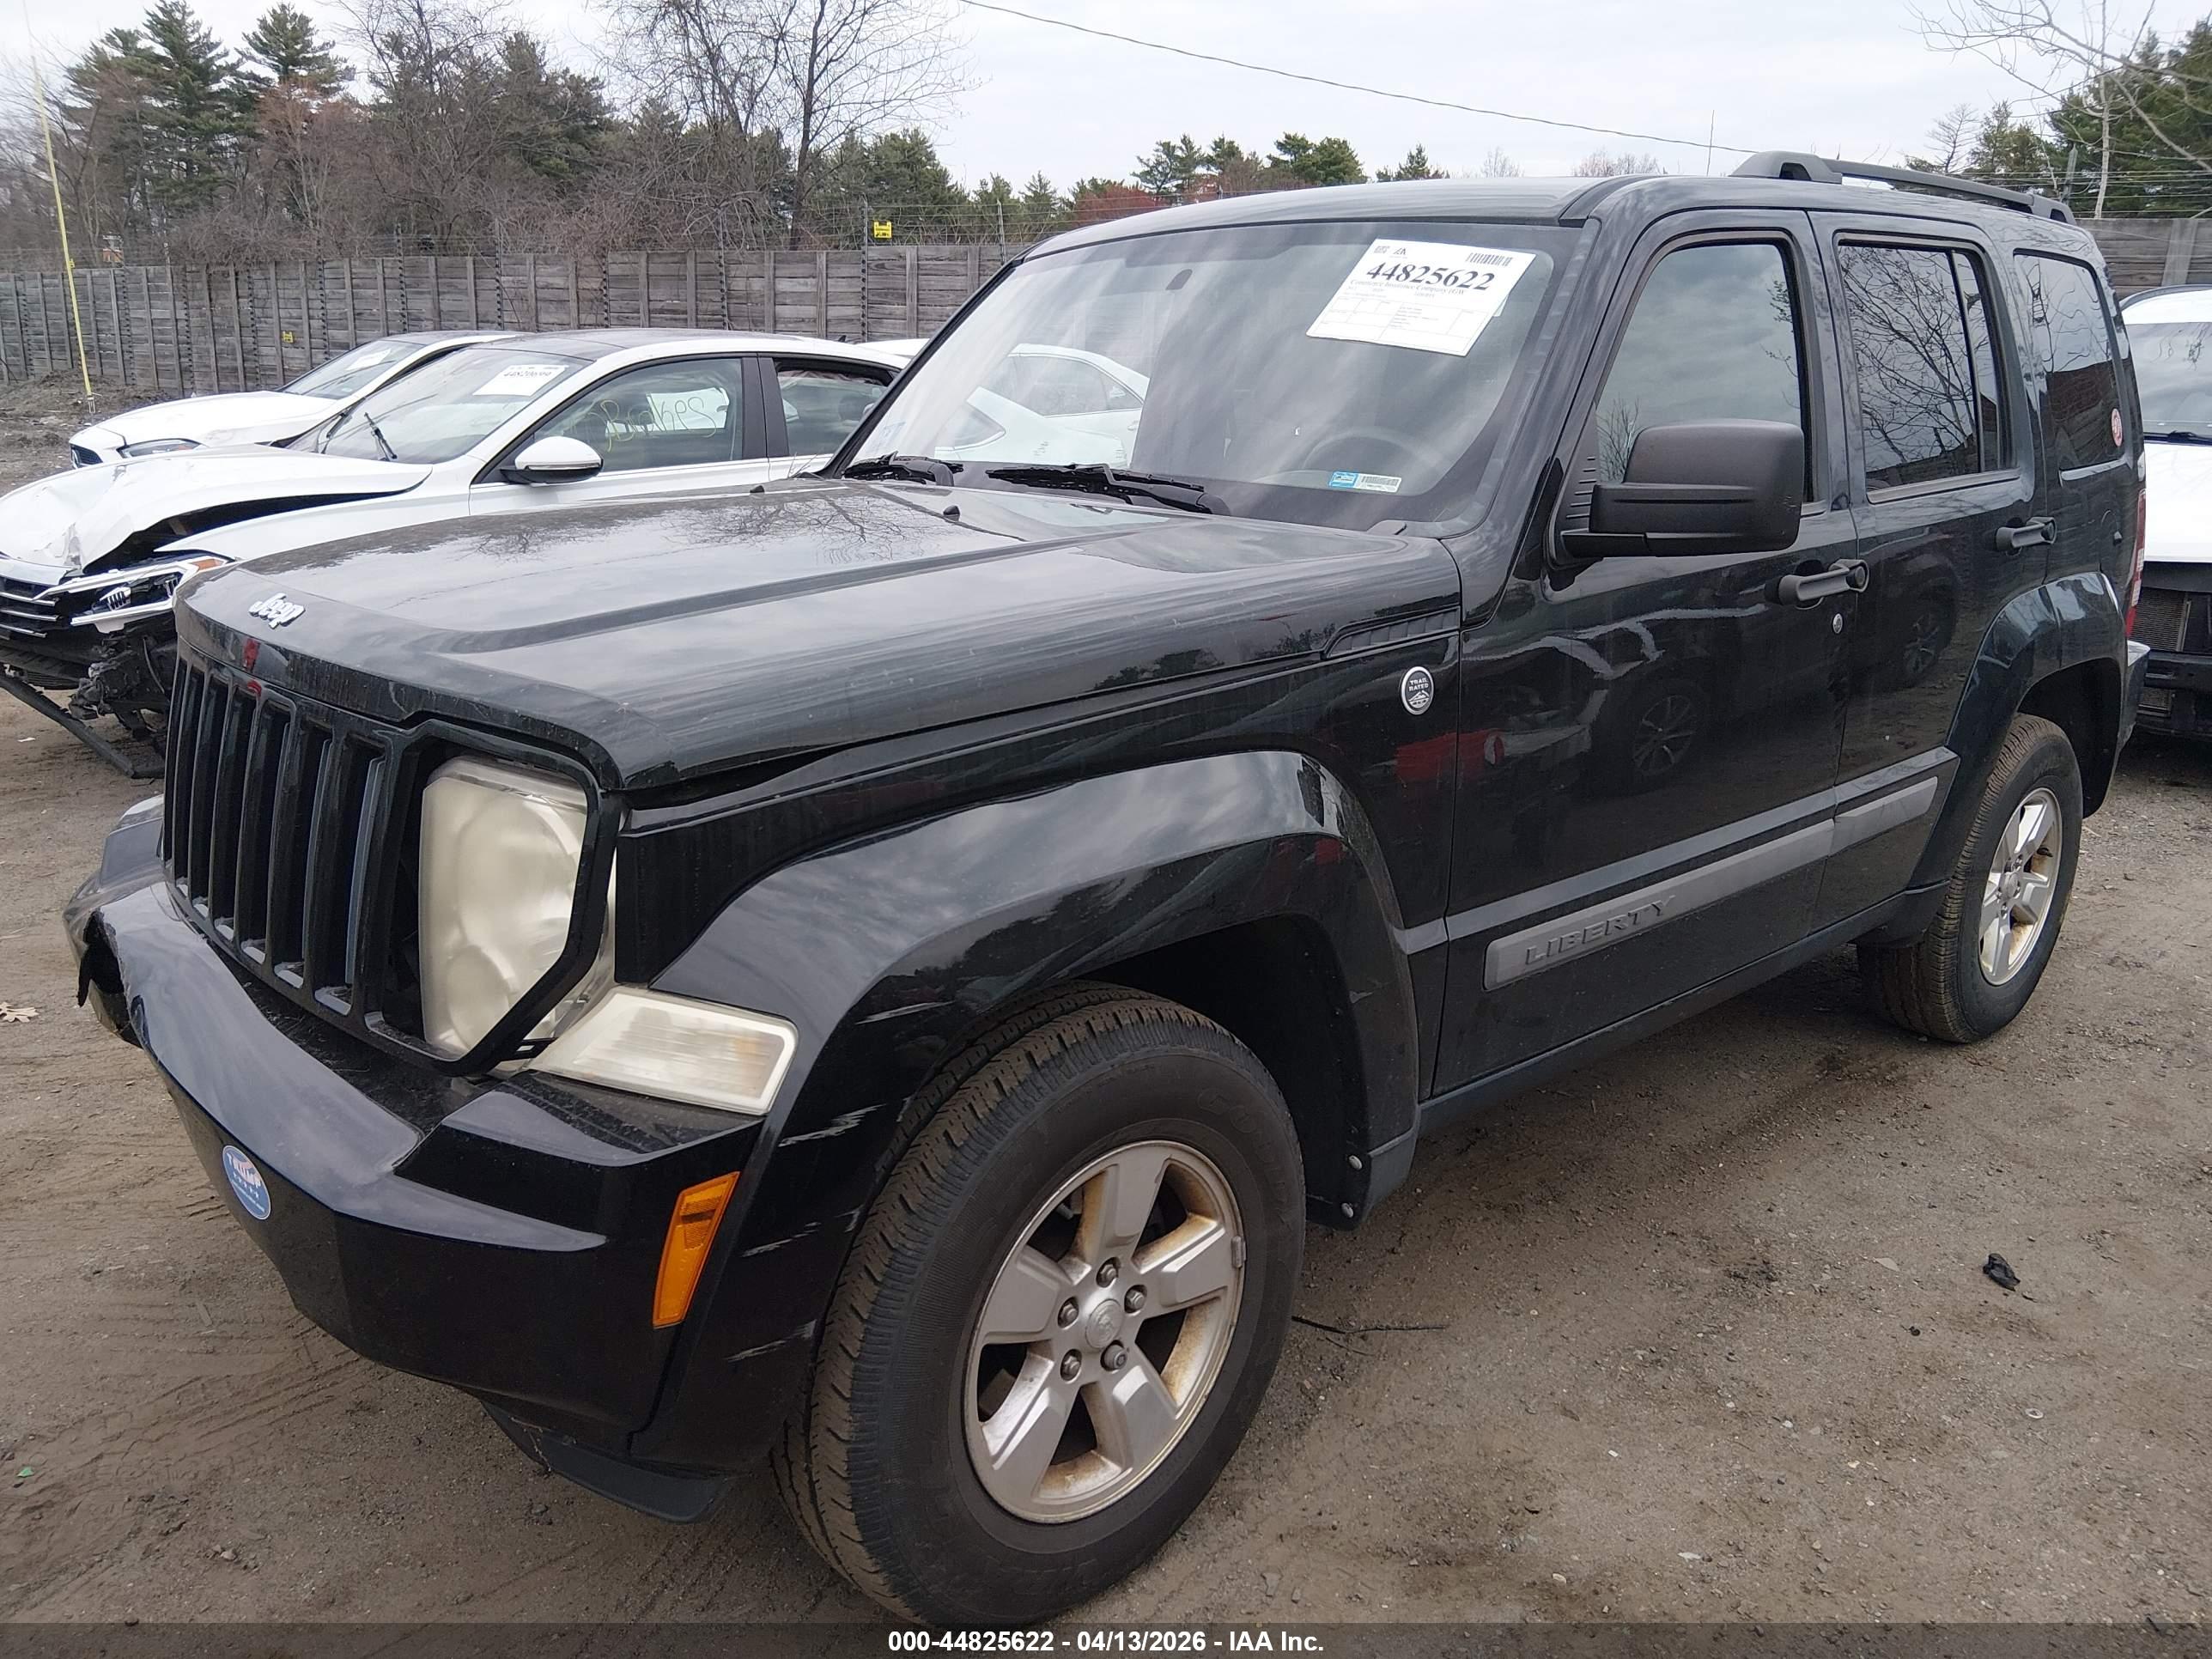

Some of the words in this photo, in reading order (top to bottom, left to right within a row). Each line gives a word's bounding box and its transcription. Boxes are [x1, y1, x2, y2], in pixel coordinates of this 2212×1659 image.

[1367, 262, 1495, 290] 44825622
[248, 592, 306, 629] Jeep
[1409, 677, 1428, 685] TRAIL
[1525, 895, 1676, 965] LIBERTY
